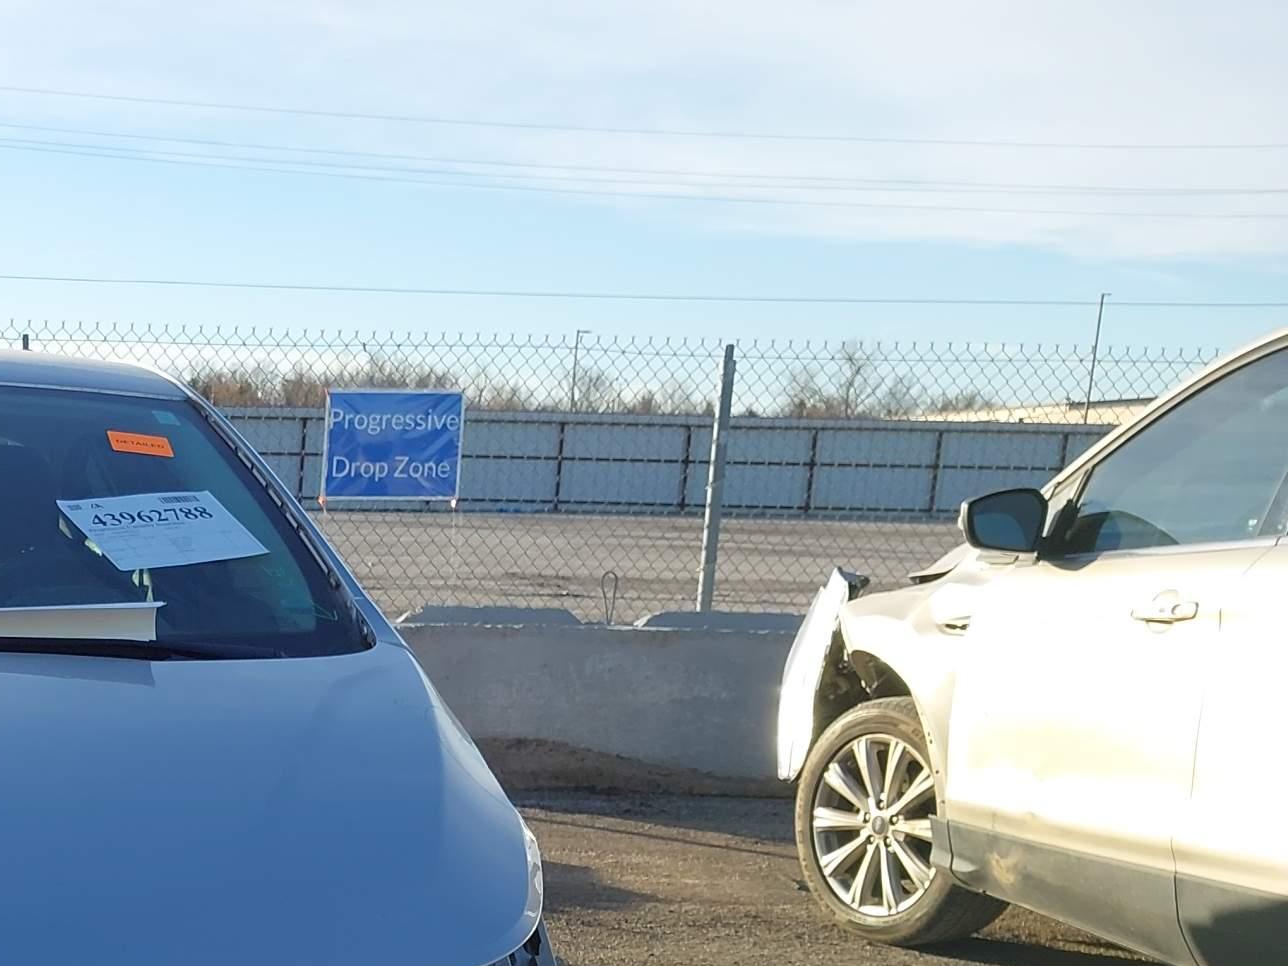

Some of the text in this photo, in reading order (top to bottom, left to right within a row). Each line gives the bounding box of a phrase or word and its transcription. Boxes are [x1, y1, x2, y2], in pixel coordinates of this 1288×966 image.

[330, 408, 459, 435] Progressive
[332, 456, 450, 481] Drop Zone
[91, 505, 214, 527] 43962788
